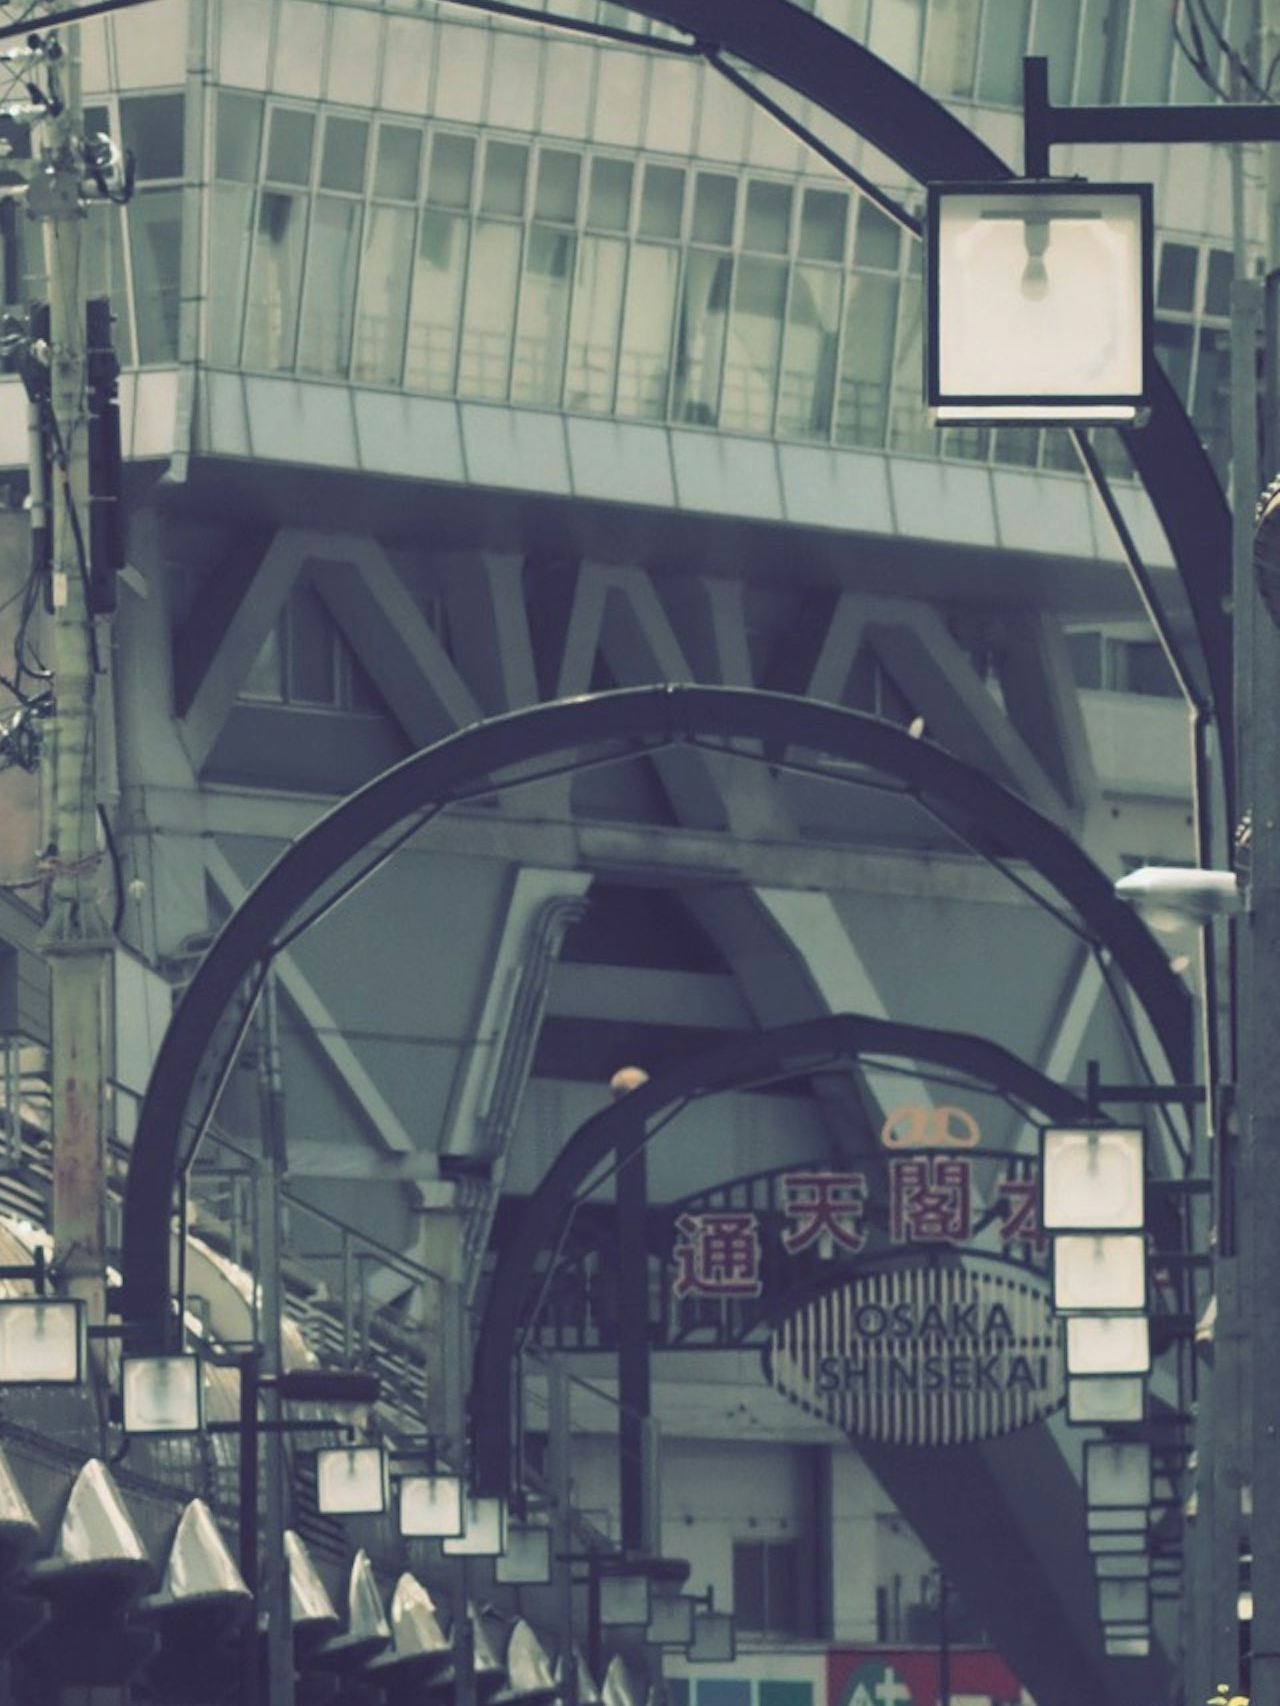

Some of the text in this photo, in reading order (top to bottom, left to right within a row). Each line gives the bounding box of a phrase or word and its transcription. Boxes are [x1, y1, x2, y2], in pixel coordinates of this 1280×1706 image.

[672, 1153, 1170, 1301] 通天閣本
[854, 1302, 1016, 1338] OSAKA
[818, 1356, 1048, 1392] SHINSEKAI
